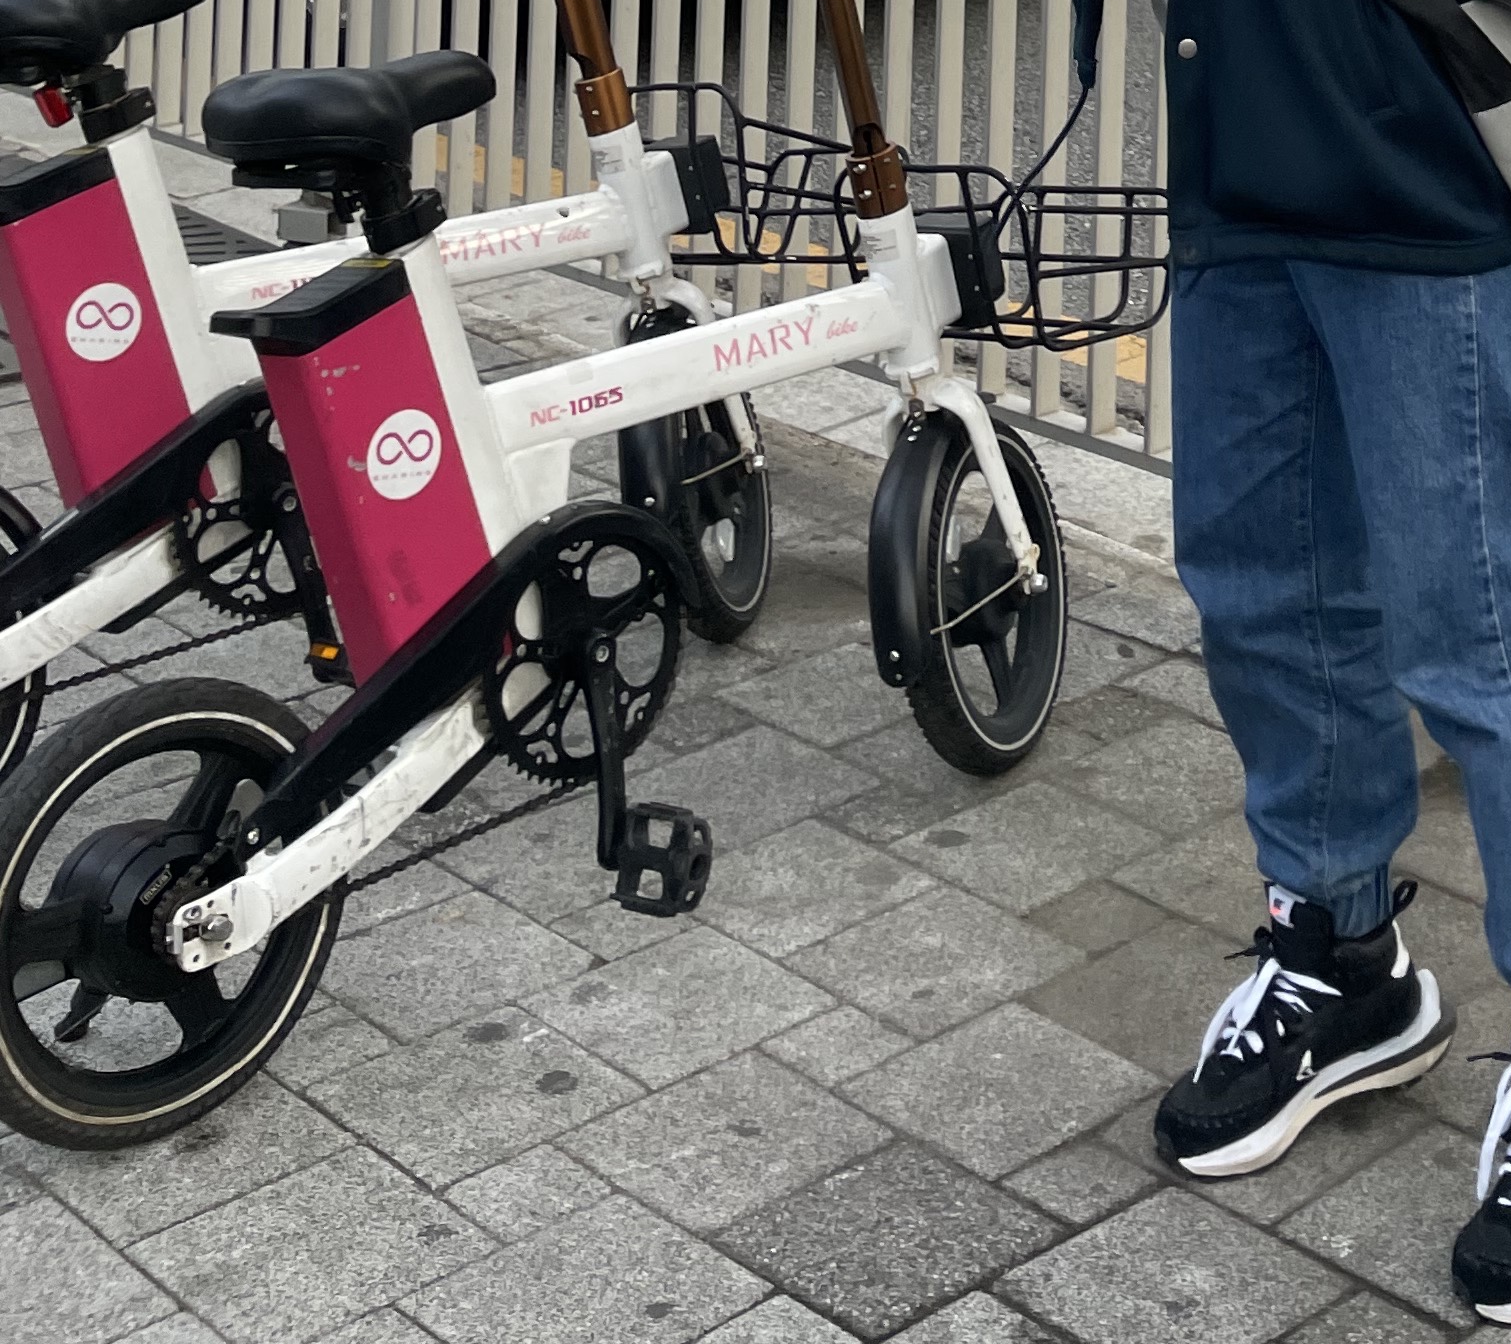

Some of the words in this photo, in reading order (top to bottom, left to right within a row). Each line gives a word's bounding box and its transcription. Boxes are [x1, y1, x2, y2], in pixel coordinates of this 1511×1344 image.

[440, 222, 548, 266] MARY
[557, 225, 592, 244] bike
[251, 276, 317, 301] NC-1
[713, 316, 815, 373] MARY
[825, 317, 860, 340] bike
[529, 385, 624, 428] NC-1065
